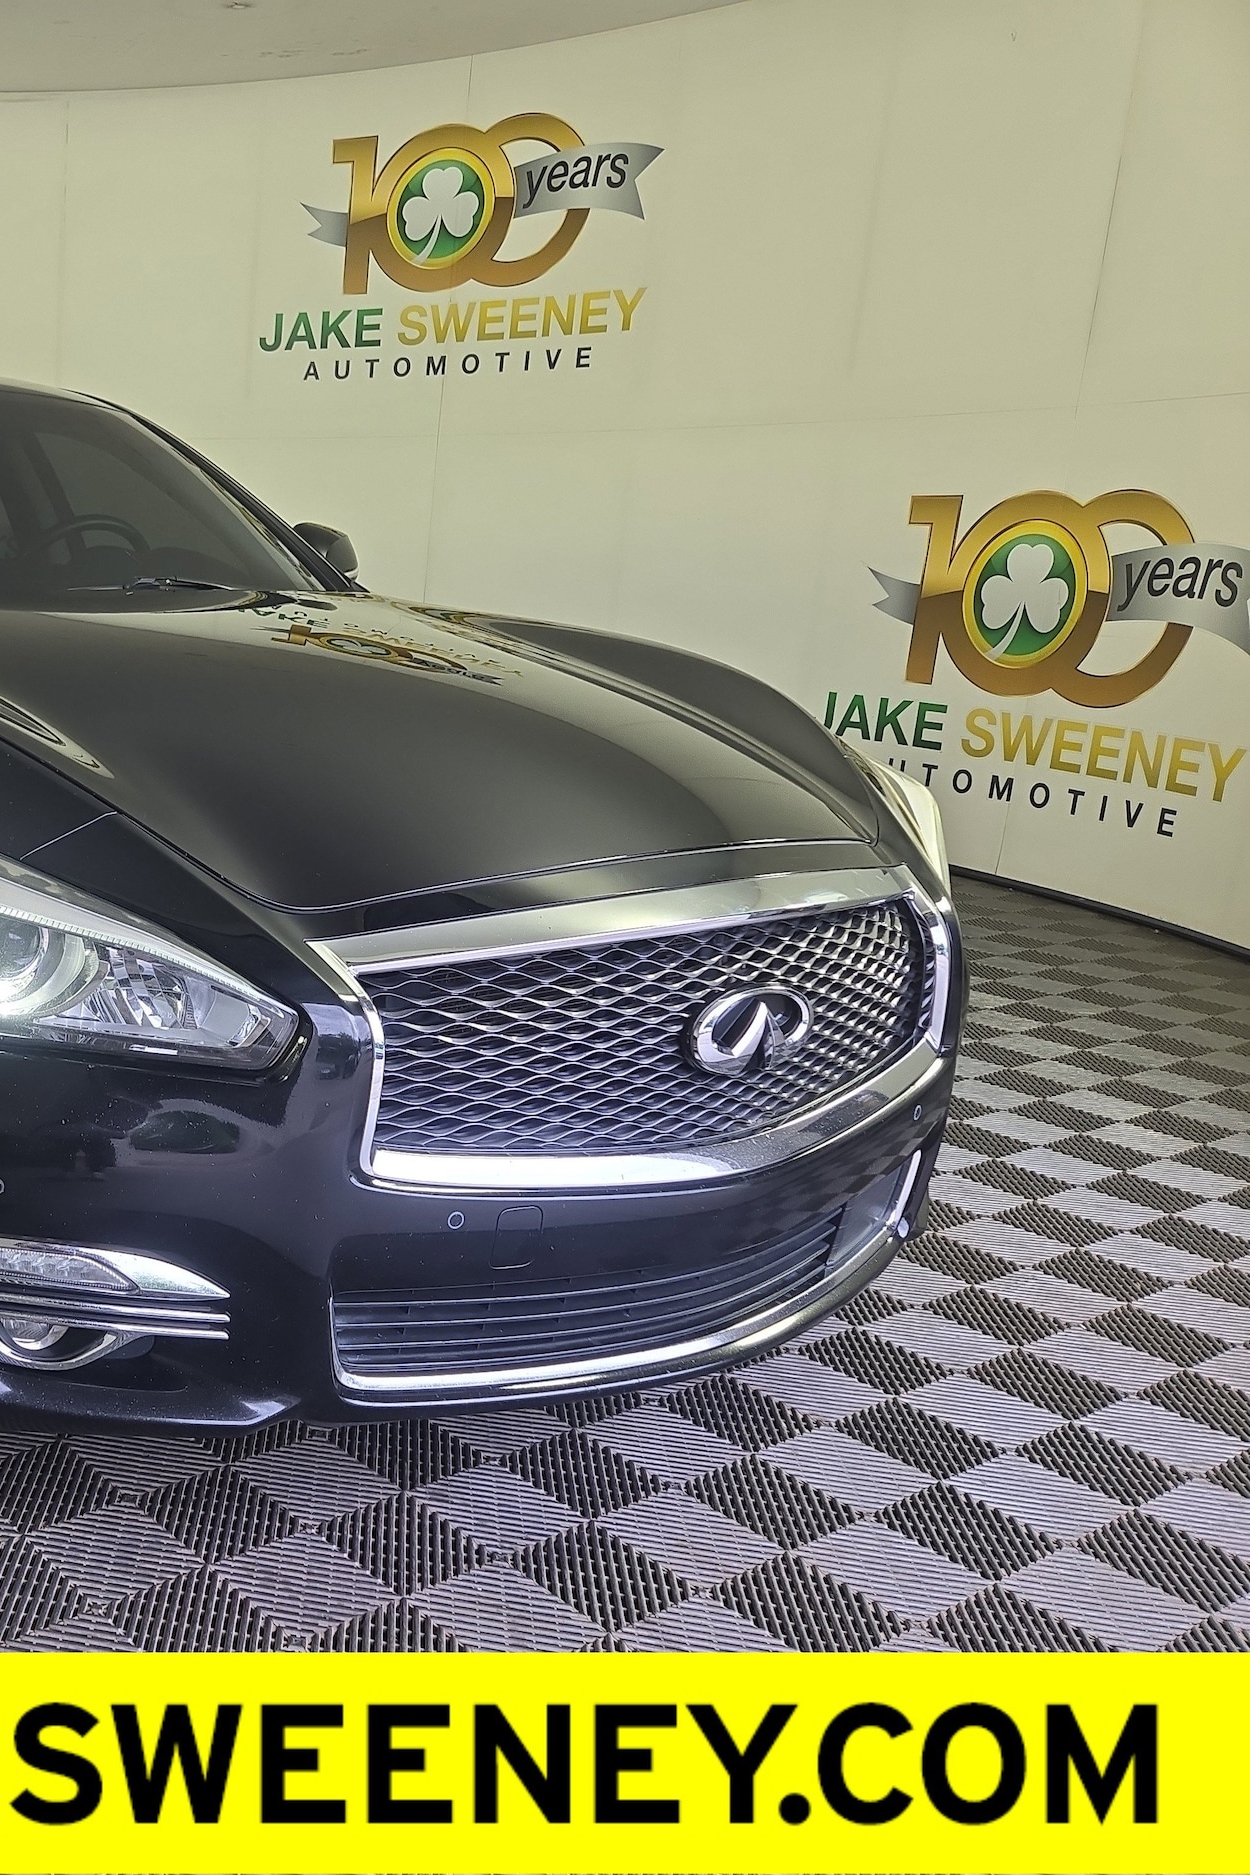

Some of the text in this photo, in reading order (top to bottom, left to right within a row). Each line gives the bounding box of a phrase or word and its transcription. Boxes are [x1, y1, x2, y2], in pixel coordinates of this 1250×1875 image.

[522, 151, 630, 209] years
[259, 287, 648, 352] JAKE SWEENEY
[303, 346, 592, 382] AUTOMOTIVE
[1117, 554, 1243, 612] years
[961, 707, 1247, 802] SWEENEY
[888, 757, 1177, 838] TOMOTIVE
